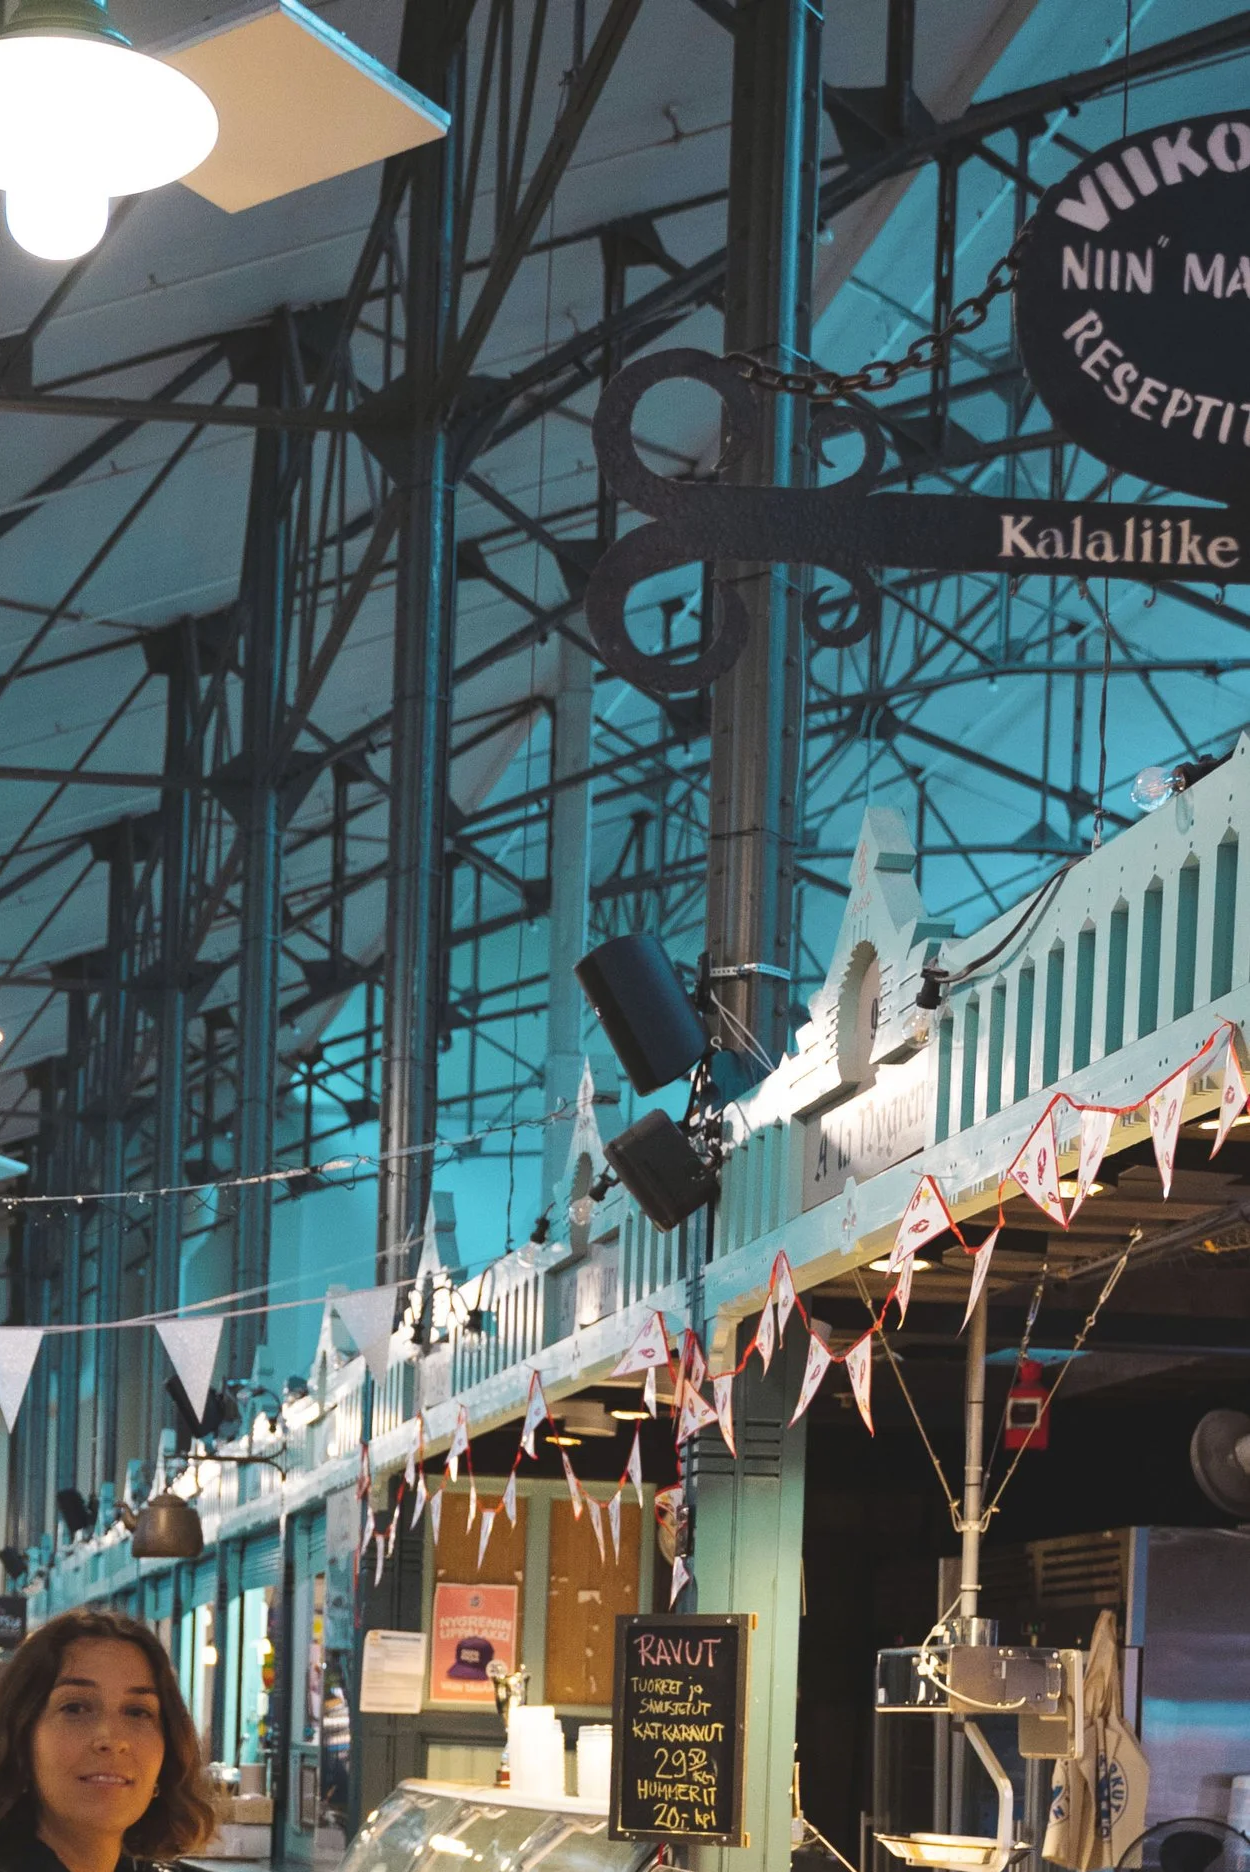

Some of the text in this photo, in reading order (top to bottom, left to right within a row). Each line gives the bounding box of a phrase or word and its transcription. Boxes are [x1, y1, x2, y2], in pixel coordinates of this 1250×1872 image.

[998, 514, 1240, 569] Kalaliike
[440, 1615, 512, 1629] NYGRENIN
[633, 1634, 721, 1668] RAVUT
[630, 1677, 684, 1696] TUOREET
[632, 1718, 725, 1743] KATKARAVUT
[637, 1779, 718, 1807] HUMMERIT
